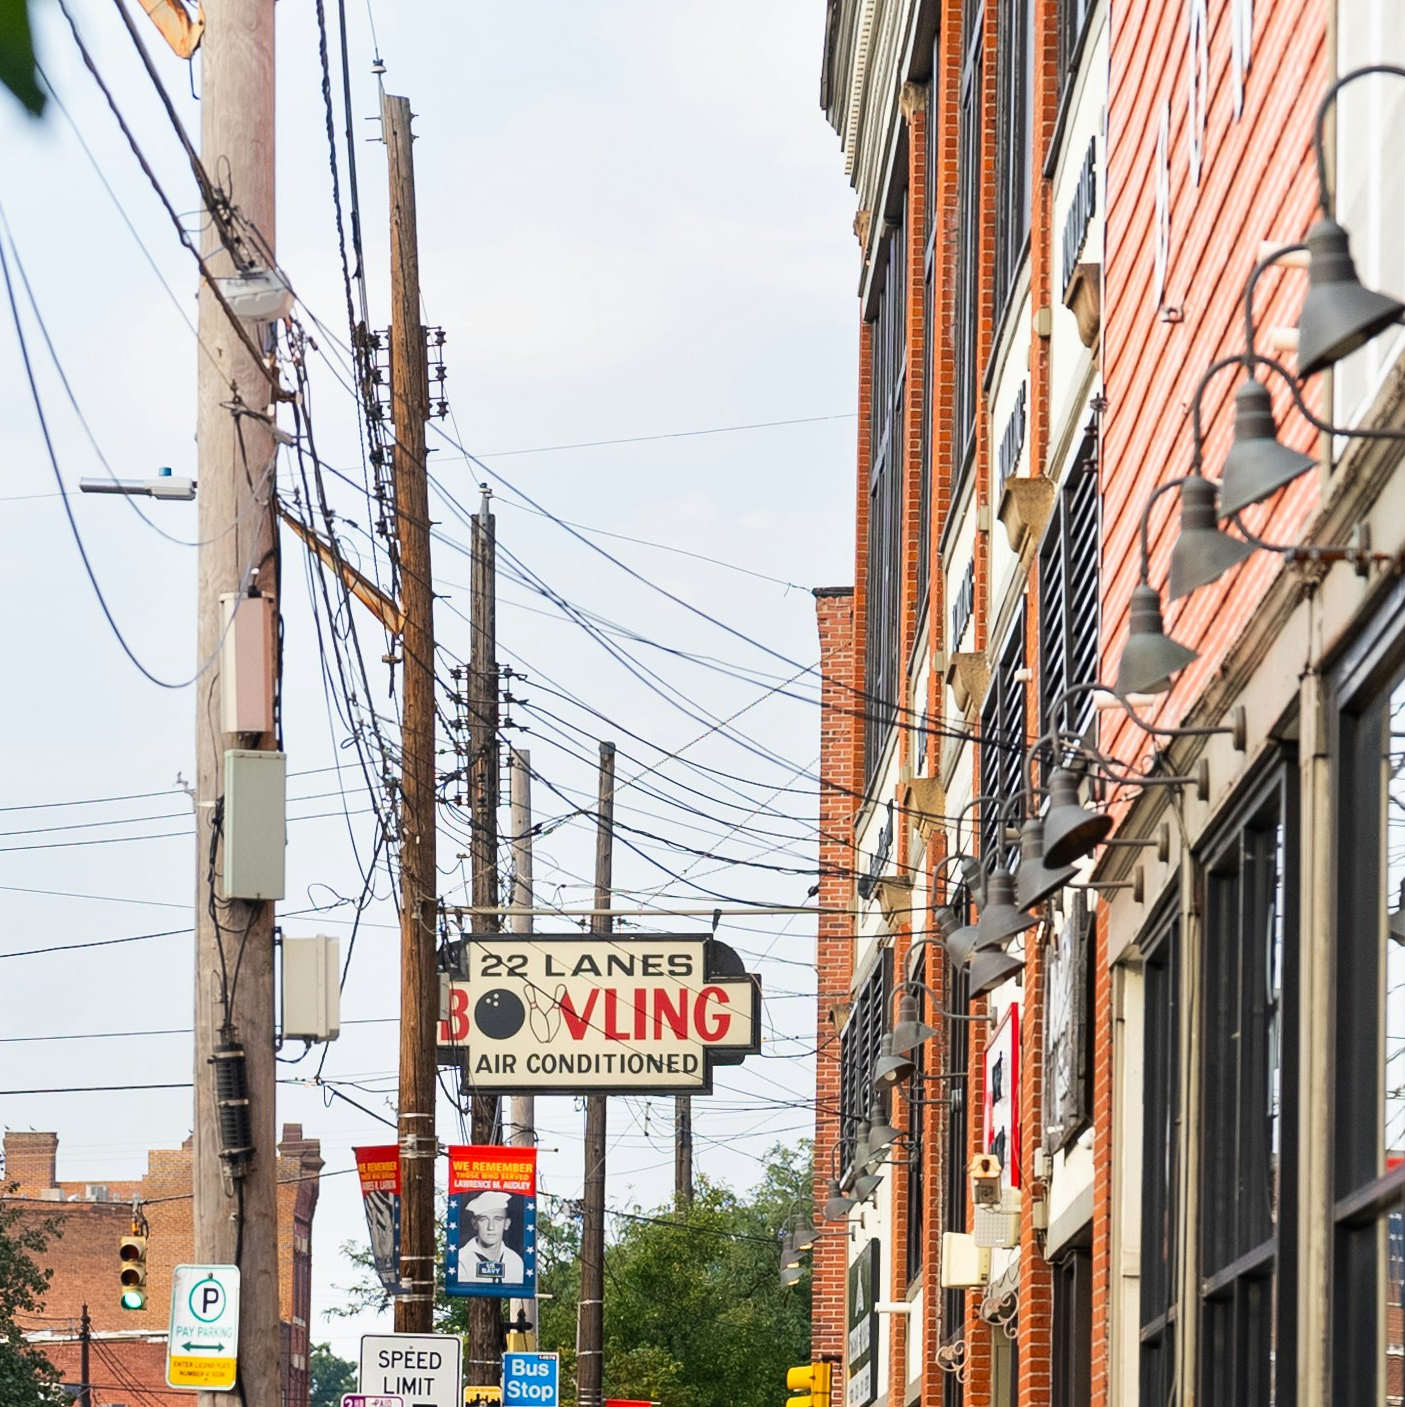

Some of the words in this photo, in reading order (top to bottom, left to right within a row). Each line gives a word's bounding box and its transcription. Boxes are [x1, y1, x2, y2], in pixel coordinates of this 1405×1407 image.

[480, 954, 528, 977] 22
[545, 954, 693, 977] LANES
[475, 1053, 516, 1074] AIR
[526, 1053, 698, 1074] CONDITIONED
[453, 1161, 469, 1171] WE
[472, 1162, 533, 1173] REMEMBER
[481, 1172, 499, 1180] WHO
[501, 1173, 529, 1181] SERVED
[454, 1179, 491, 1189] LAWRENCE
[202, 1288, 219, 1314] P
[176, 1325, 195, 1338] PAY
[197, 1326, 233, 1338] PARKING
[378, 1350, 442, 1370] SPEED
[511, 1358, 549, 1377] Bus
[383, 1376, 435, 1396] LIMIT
[506, 1380, 554, 1402] Stop
